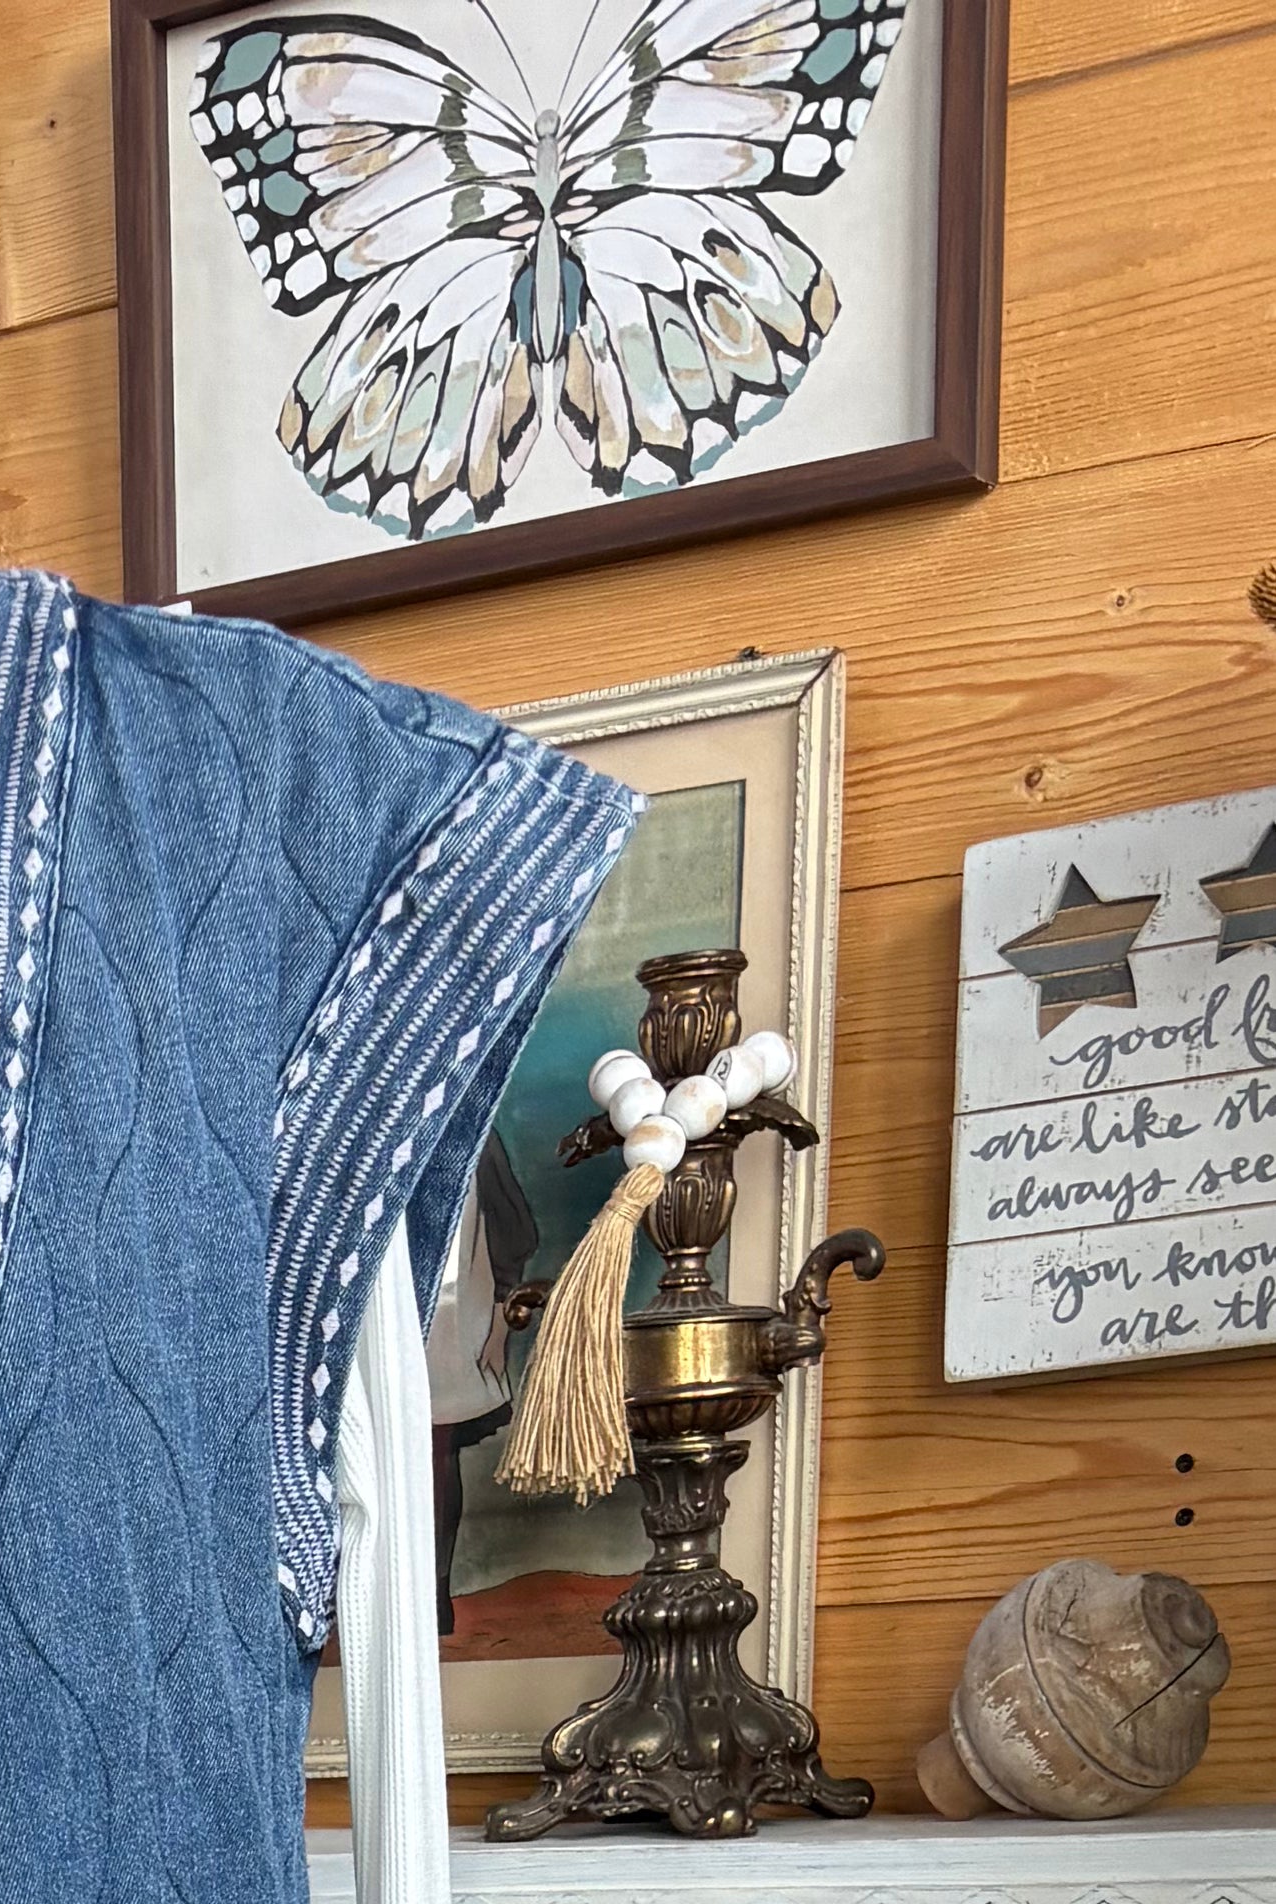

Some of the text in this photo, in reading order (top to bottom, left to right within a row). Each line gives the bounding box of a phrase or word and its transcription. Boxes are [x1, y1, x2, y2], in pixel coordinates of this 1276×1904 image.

[1049, 983, 1231, 1090] good
[970, 1122, 1063, 1162] are
[1070, 1096, 1201, 1155] like
[987, 1168, 1177, 1224] always
[1033, 1257, 1142, 1324] you
[1100, 1303, 1199, 1346] are
